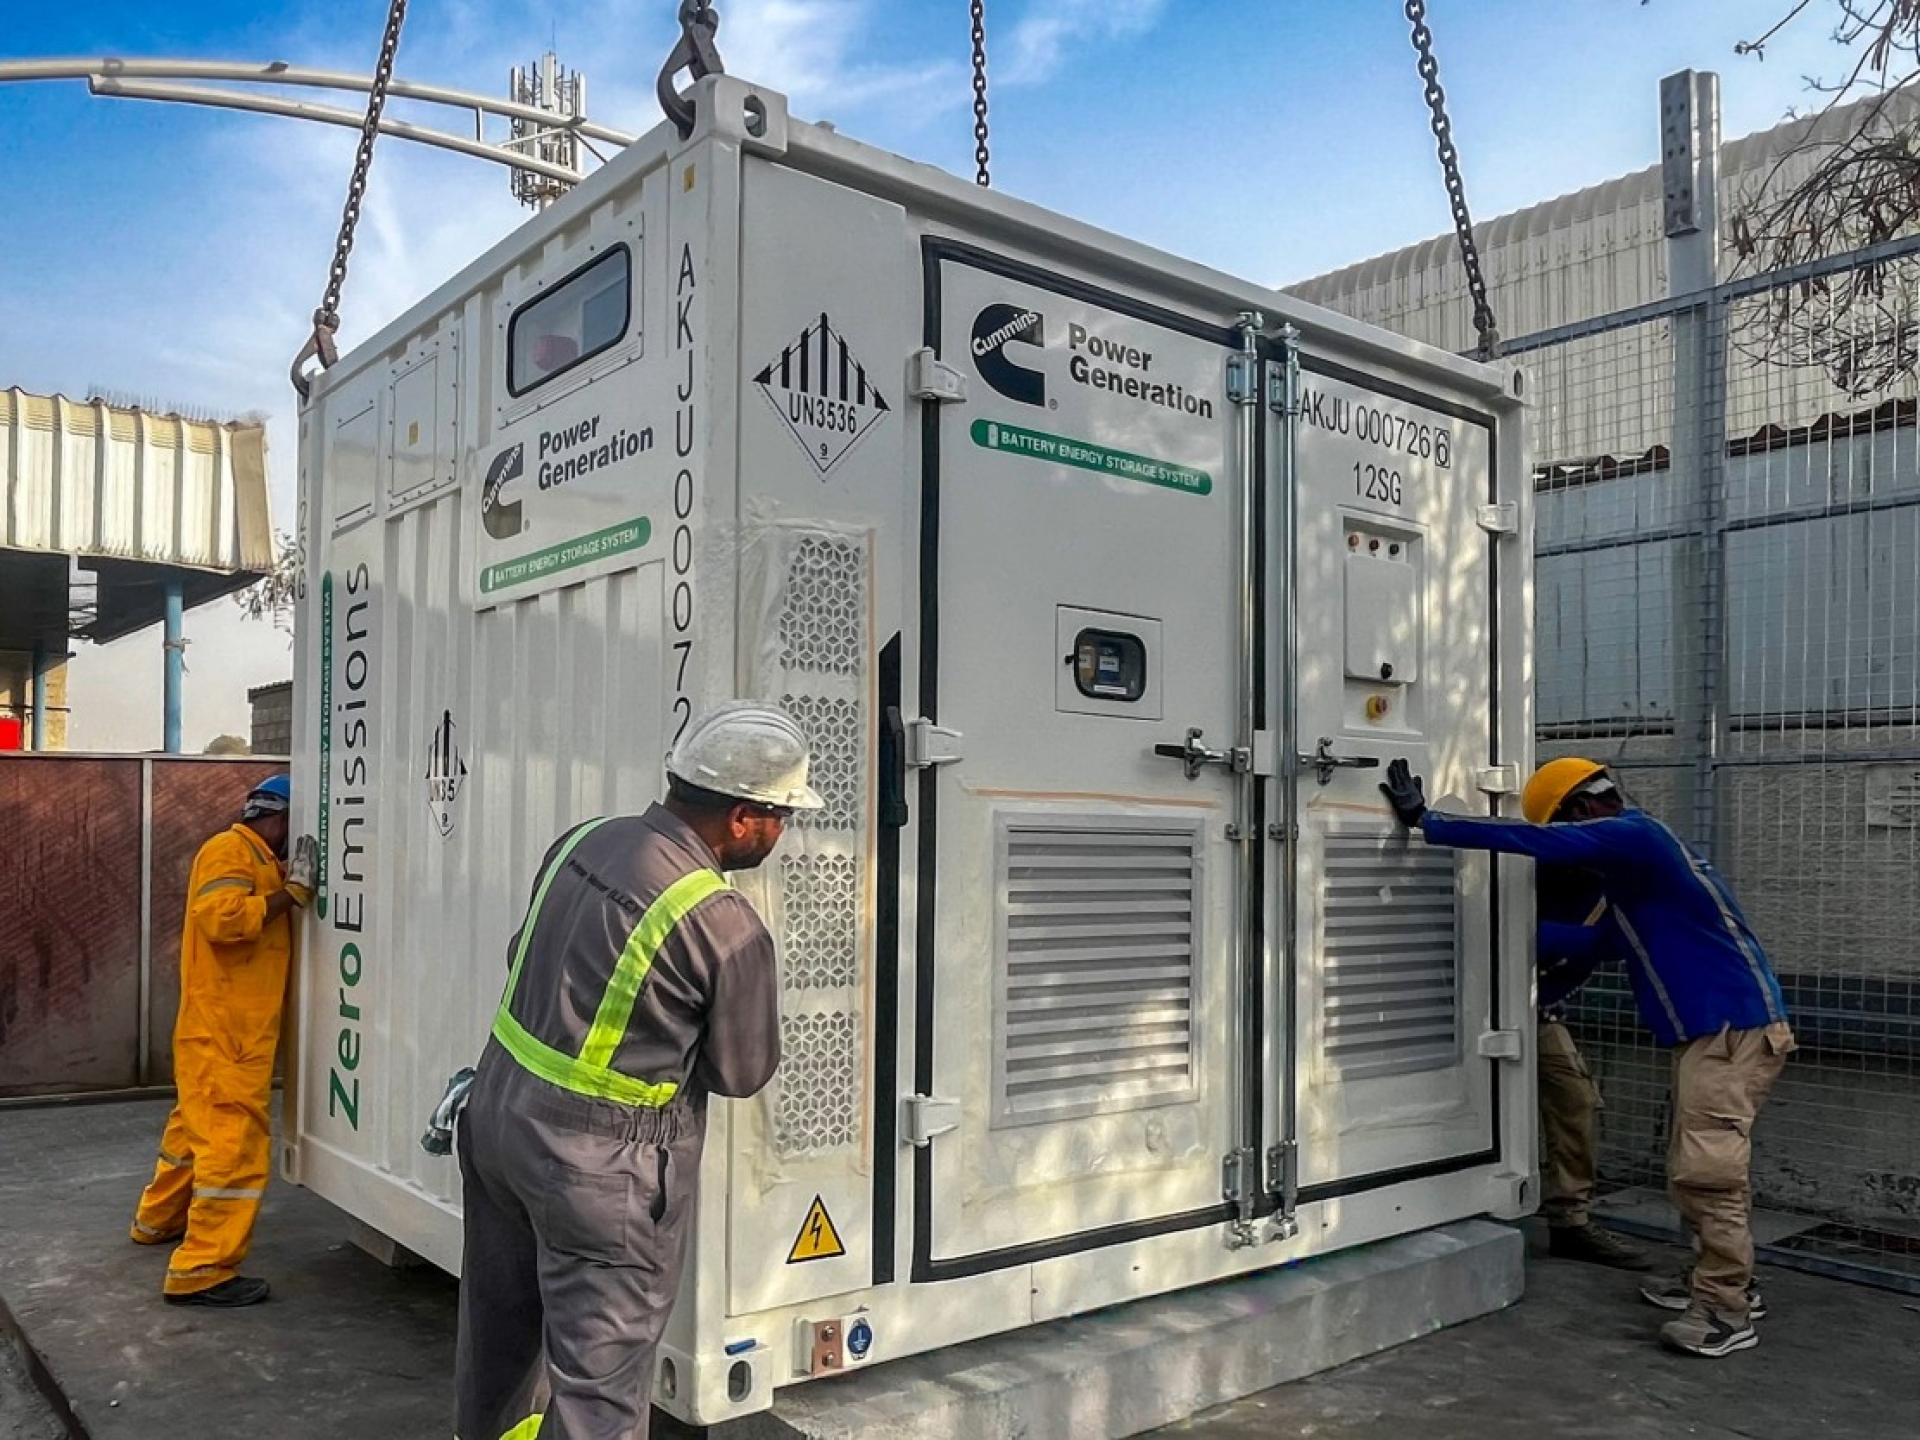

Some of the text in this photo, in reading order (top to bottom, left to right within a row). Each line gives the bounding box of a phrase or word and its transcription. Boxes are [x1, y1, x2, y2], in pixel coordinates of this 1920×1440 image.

[971, 310, 1040, 357] Cummins
[1068, 322, 1153, 372] Power
[788, 391, 857, 434] UN3536
[1069, 355, 1213, 419] Generation
[538, 414, 601, 460] Power
[1300, 387, 1350, 435] AKJU
[1356, 405, 1431, 459] 000726
[538, 425, 654, 491] Generation
[819, 443, 828, 458] 9
[1001, 430, 1200, 488] BATTERY ENERGY STORAGE SYSTEM
[482, 444, 522, 514] Cummins
[1353, 461, 1401, 506] 12SG
[494, 526, 639, 583] BATTERY ENERGY STORAGE SYSTEM
